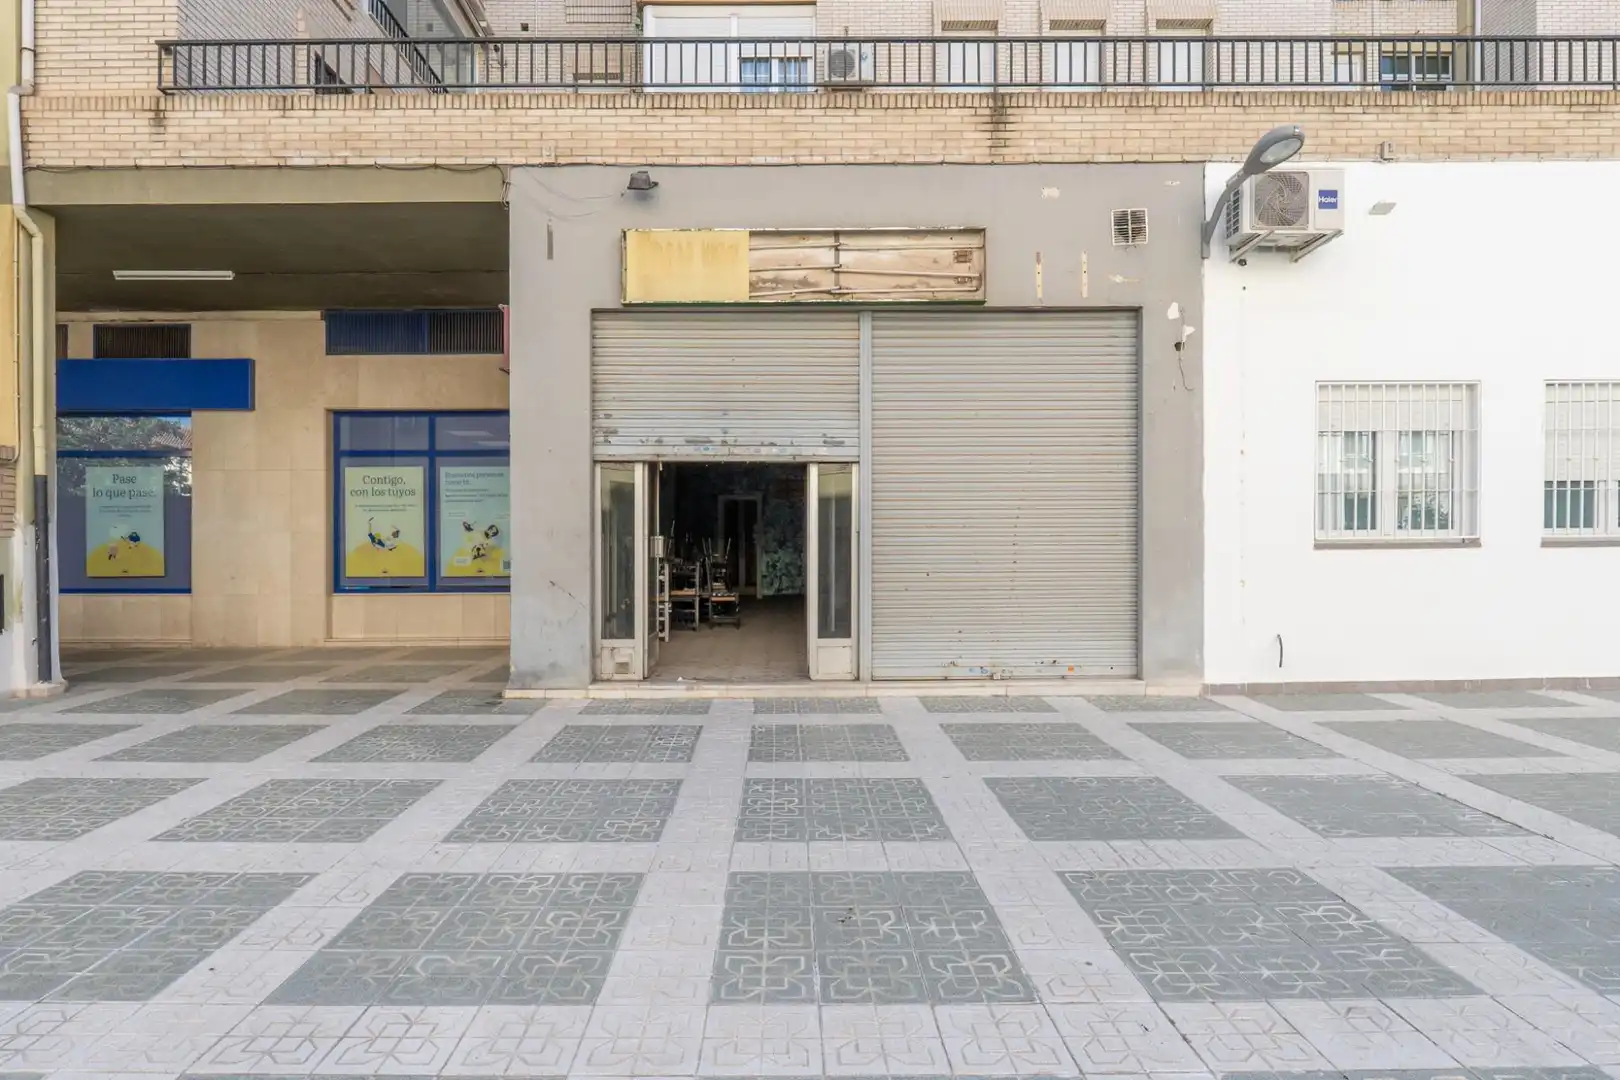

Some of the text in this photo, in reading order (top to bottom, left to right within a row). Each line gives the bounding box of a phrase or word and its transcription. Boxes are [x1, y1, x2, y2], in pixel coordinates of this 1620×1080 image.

[1318, 196, 1337, 204] Haier
[112, 473, 137, 484] Pase
[362, 475, 406, 486] Contigo,
[92, 487, 103, 498] lo
[105, 488, 126, 499] que
[350, 487, 416, 499] con los tuyos
